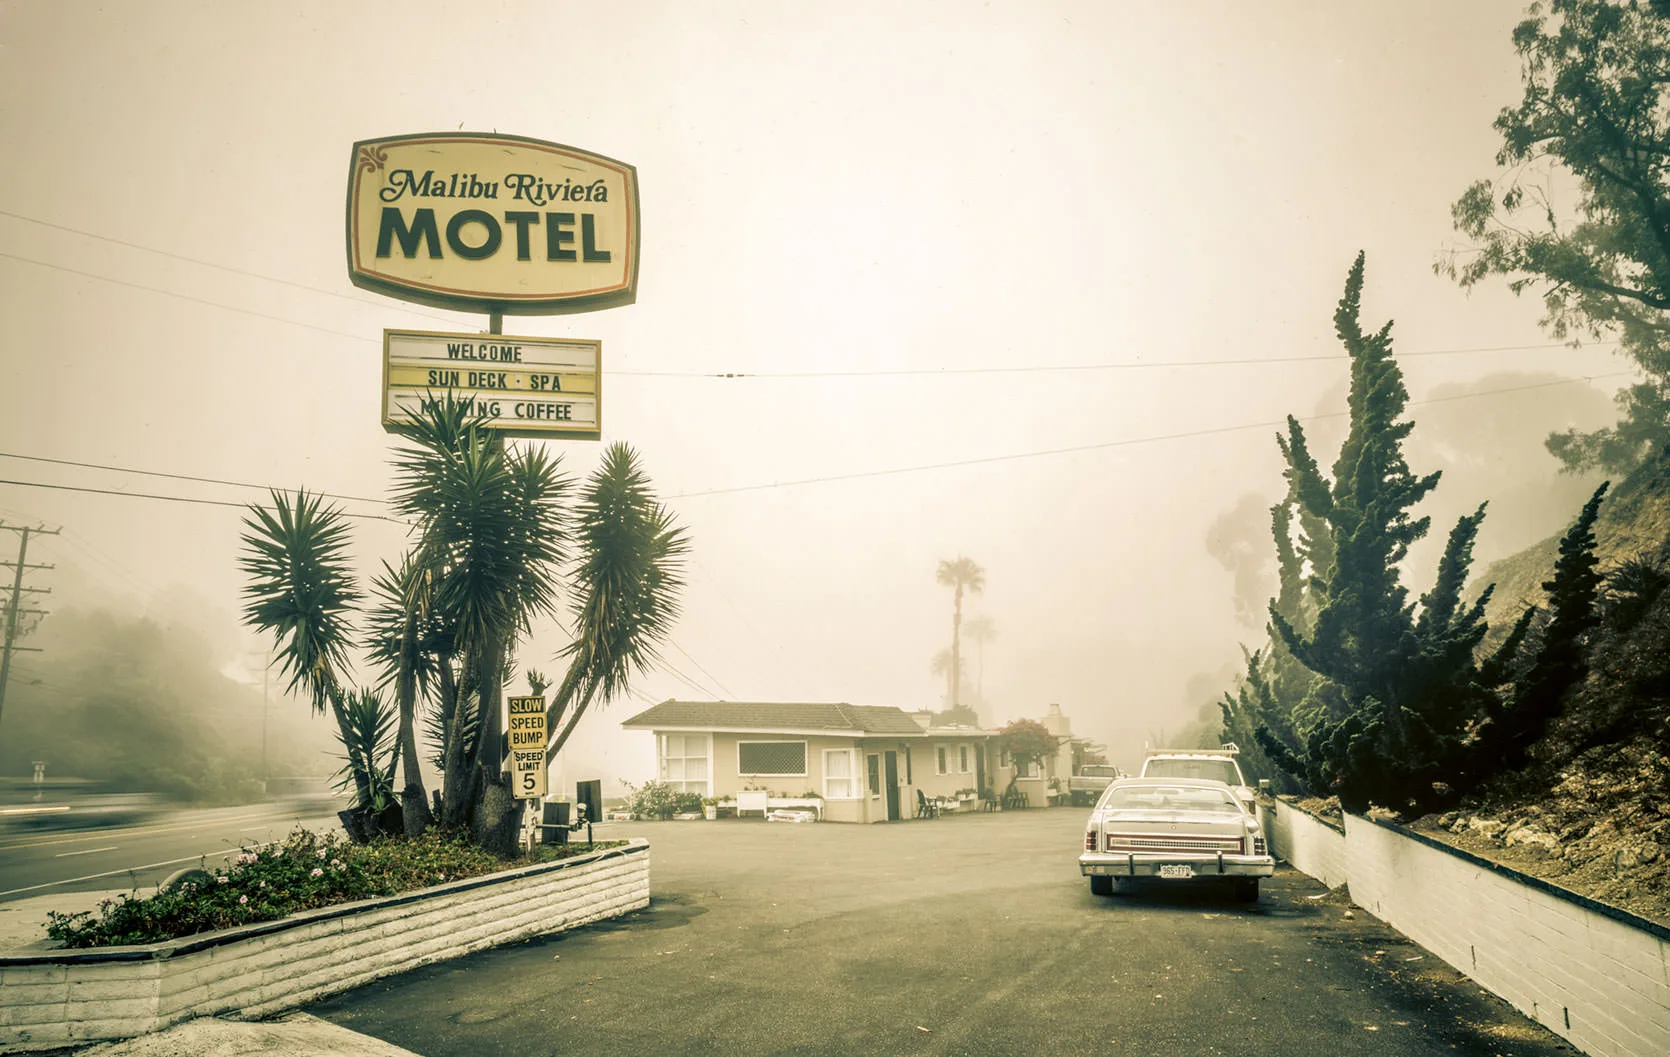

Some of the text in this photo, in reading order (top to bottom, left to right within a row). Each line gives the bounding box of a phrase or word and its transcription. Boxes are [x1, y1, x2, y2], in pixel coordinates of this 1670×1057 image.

[379, 169, 608, 206] Malibu Riviera
[376, 207, 611, 263] MOTEL
[447, 343, 522, 363] WELCOME
[428, 370, 561, 391] SUN DECK SPA
[421, 399, 572, 420] MING COFFEE
[511, 699, 542, 713] SLOW
[511, 717, 544, 730] SPEED
[513, 731, 543, 745] BUMP
[515, 752, 543, 762] SPEED
[518, 762, 540, 771] LIMIT
[523, 773, 536, 790] 5
